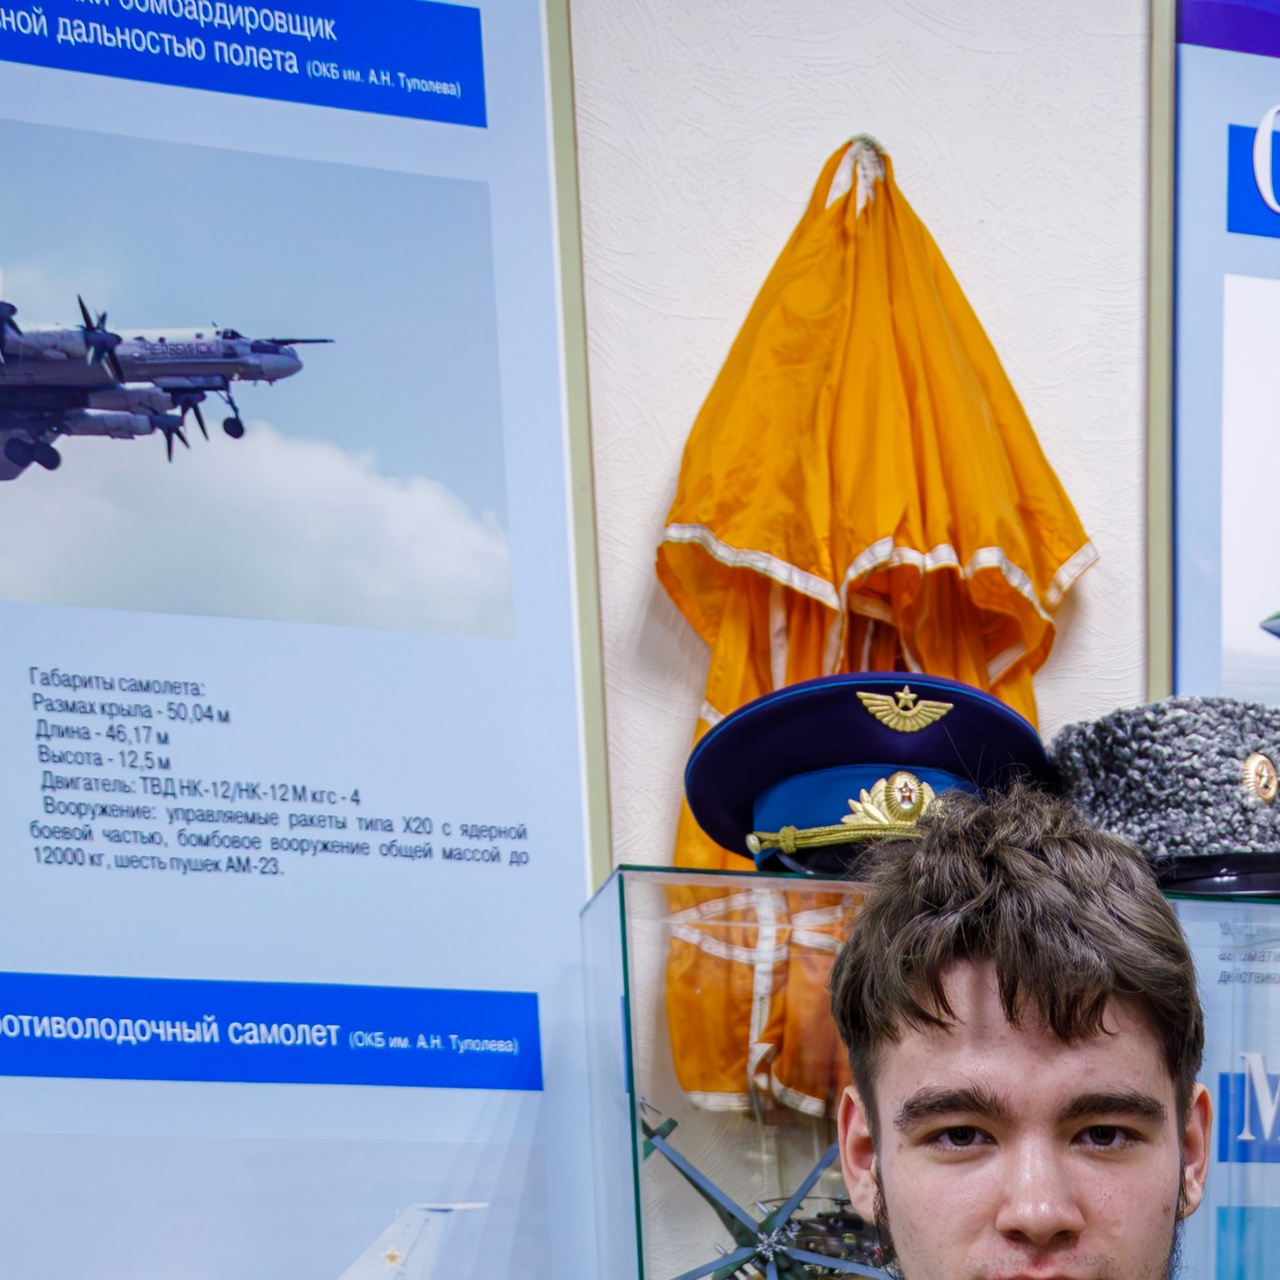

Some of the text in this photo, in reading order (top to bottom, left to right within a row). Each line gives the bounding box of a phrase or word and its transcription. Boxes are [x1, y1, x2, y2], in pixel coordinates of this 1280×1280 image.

[57, 16, 206, 61] дальностью
[214, 41, 299, 74] полета
[306, 60, 340, 79] (ОКБ
[369, 68, 395, 87] А.Н.
[29, 666, 206, 697] Габариты самолета:
[32, 692, 214, 724] Размах крыла 50,04
[35, 719, 153, 746] Длина 46,17
[38, 744, 156, 772] Высота 12,5
[41, 770, 336, 804] Двигатель: ТВД кгс
[42, 795, 528, 841] Вооружение: управляемые ракеты типа Х20 ядерной
[29, 820, 529, 867] боевой частью, бомбовое вооружение общей массой до
[33, 846, 285, 876] 12000 шесть пушек АМ-23.
[0, 1013, 220, 1046] отиволодочный
[228, 1021, 340, 1047] самолет
[348, 1031, 386, 1049] (ОКБ
